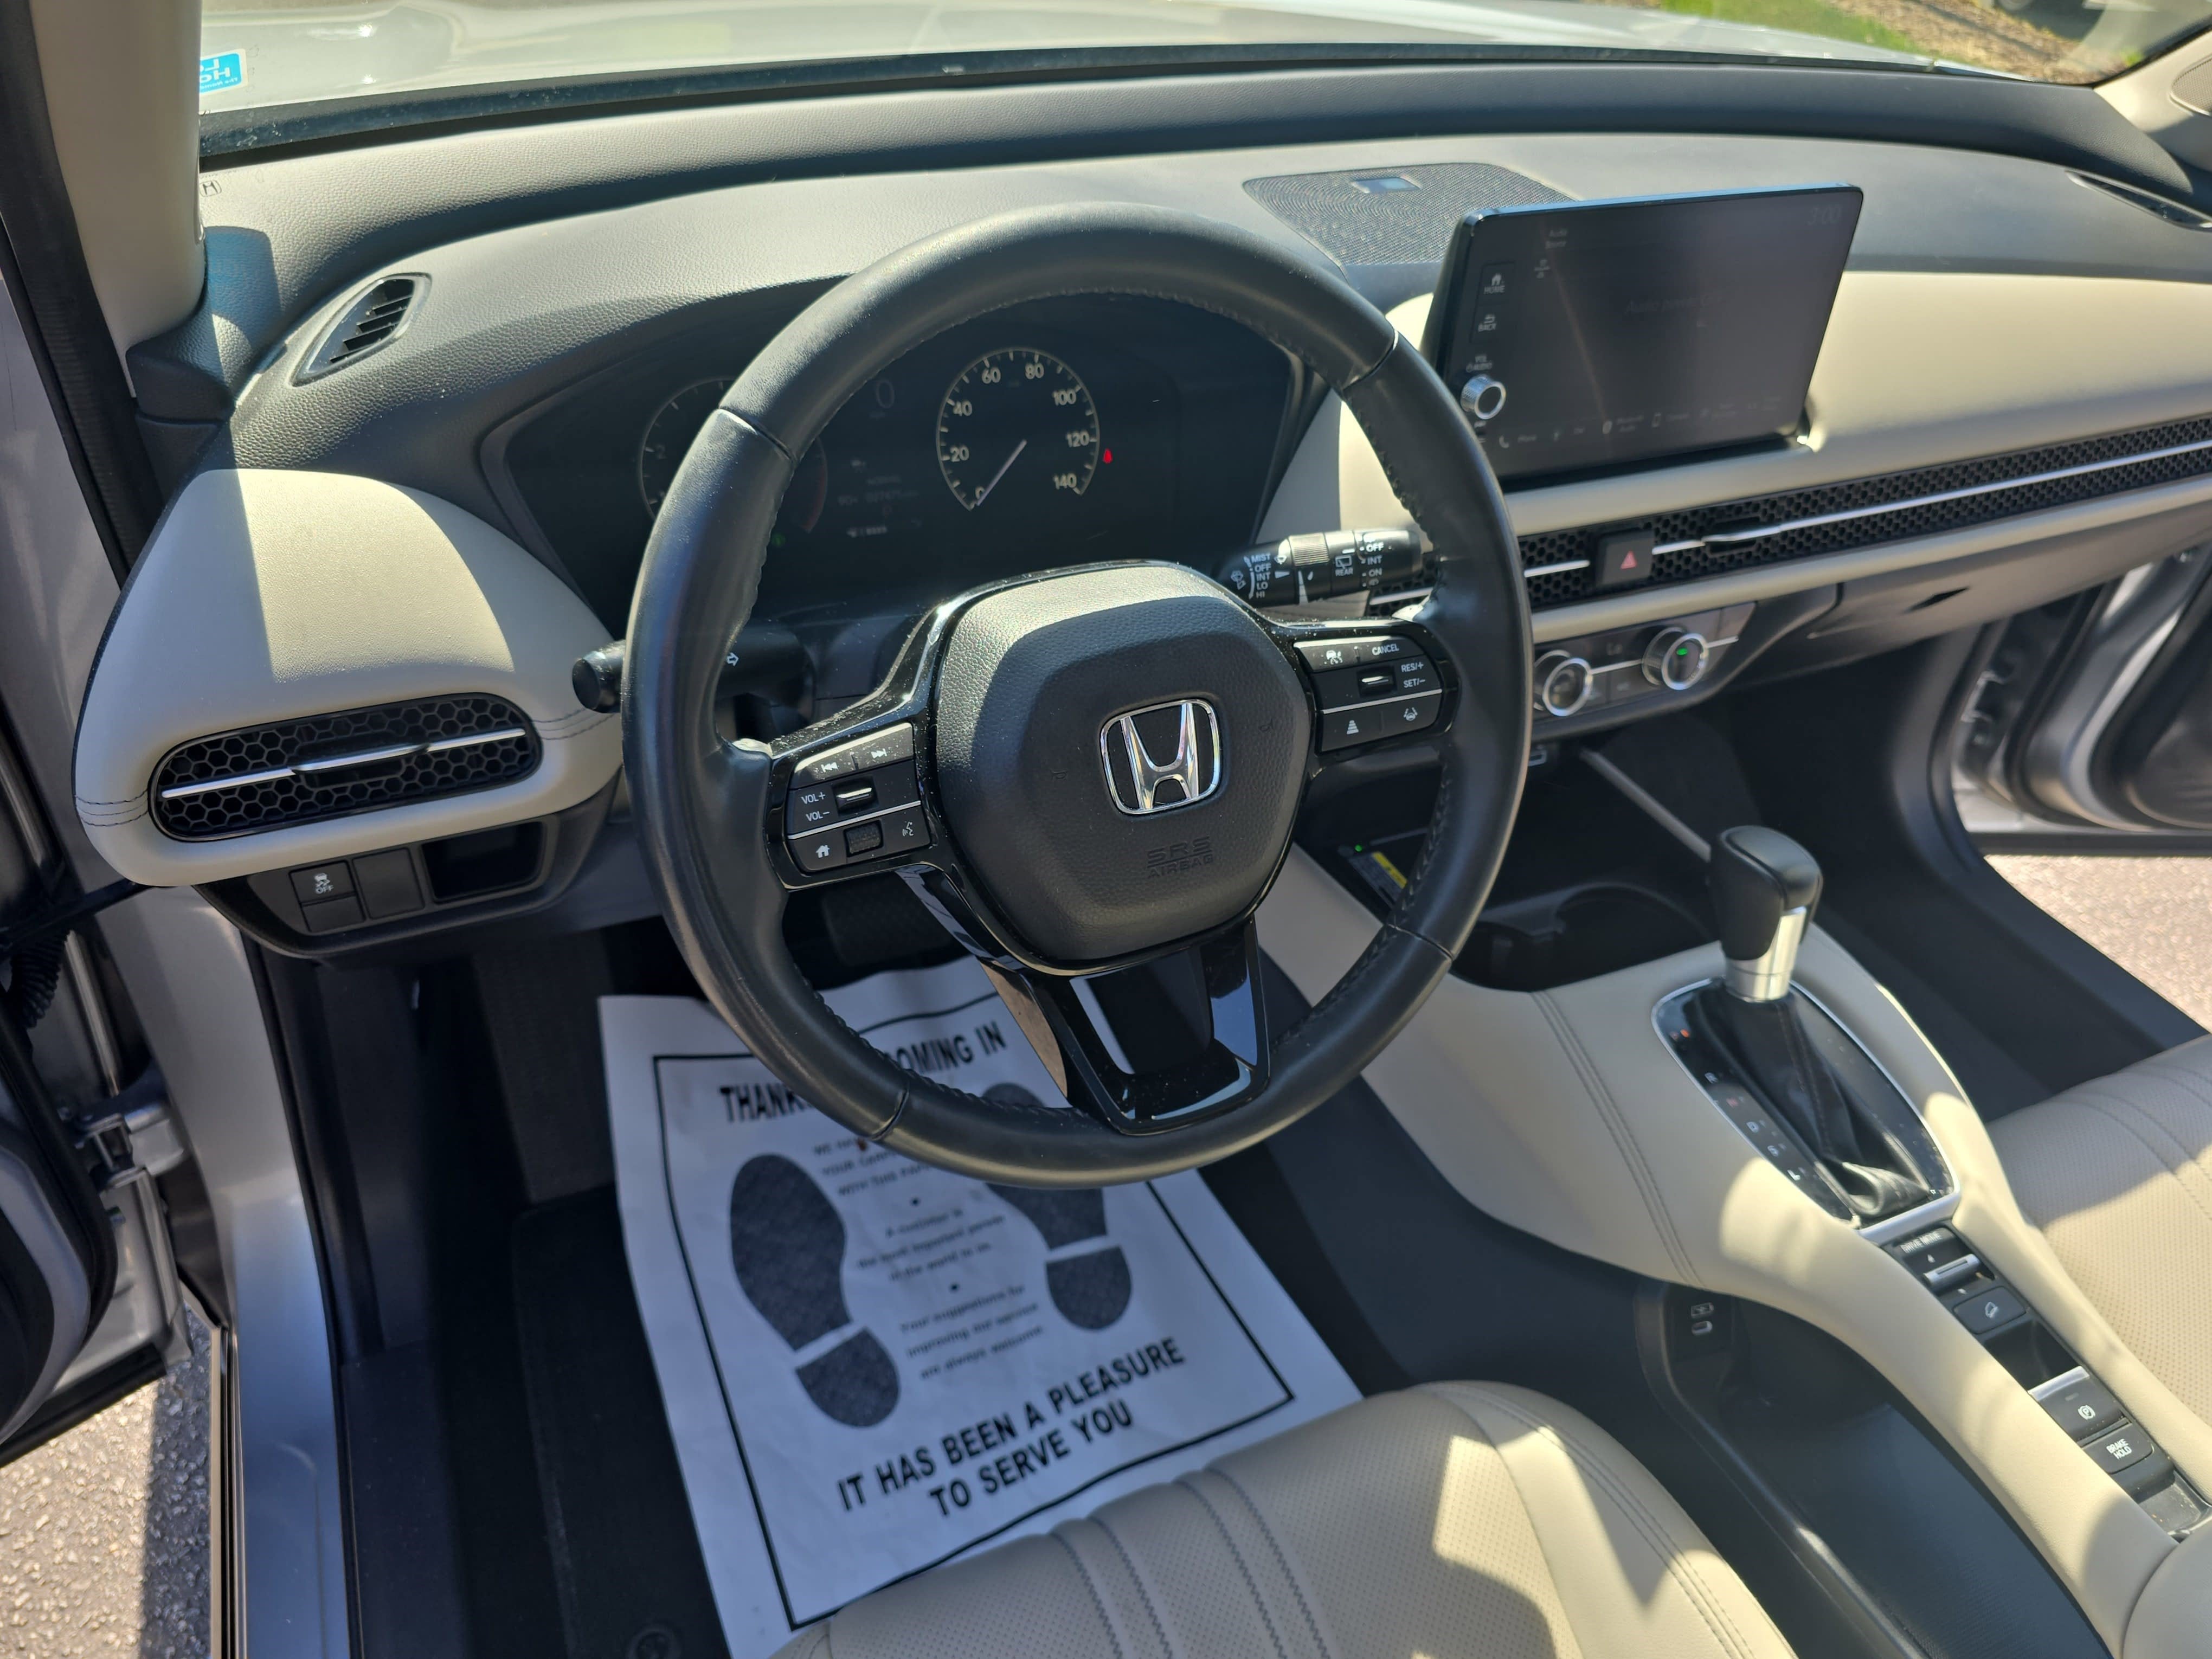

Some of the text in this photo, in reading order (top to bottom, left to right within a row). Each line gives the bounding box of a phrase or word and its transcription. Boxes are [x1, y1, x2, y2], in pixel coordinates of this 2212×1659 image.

[1484, 285, 1505, 294] HOME
[1478, 323, 1496, 332] BACK
[982, 366, 1001, 384] 60
[1025, 363, 1044, 380] 80
[1053, 389, 1077, 406] 100
[953, 400, 972, 416] 40
[1066, 430, 1090, 447] 120
[950, 445, 969, 462] 20
[1054, 473, 1077, 490] 140
[1366, 542, 1384, 552] OFF
[1251, 552, 1271, 563] MIST
[1367, 555, 1382, 565] INT
[1255, 563, 1271, 573] OFF
[1335, 567, 1353, 576] REAR
[1368, 568, 1382, 577] ON
[1256, 572, 1271, 581] INT
[1257, 582, 1268, 590] LO
[1372, 644, 1399, 655] CANCEL
[1401, 662, 1424, 673] RES/+
[801, 792, 826, 805] VOL+
[1148, 836, 1210, 864] SRS
[1148, 854, 1214, 878] AIRBAG
[316, 885, 333, 895] OFF
[720, 1020, 1006, 1123] THANK OMING IN
[1746, 1121, 1759, 1133] D
[897, 1214, 949, 1233] customer
[911, 1229, 964, 1253] important
[967, 1215, 1005, 1234] person
[1900, 1231, 1943, 1253] DRIVE MODE
[901, 1284, 1025, 1331] Your suggestions for
[907, 1328, 970, 1358] improving
[996, 1303, 1039, 1325] service
[920, 1366, 941, 1380] are
[946, 1348, 987, 1370] always
[838, 1336, 1185, 1511] IT HAS BEEN A PLEASURE
[2106, 1438, 2129, 1454] BRAKE
[2113, 1446, 2132, 1459] HOLD
[928, 1399, 1133, 1516] TO SERVE YOU
